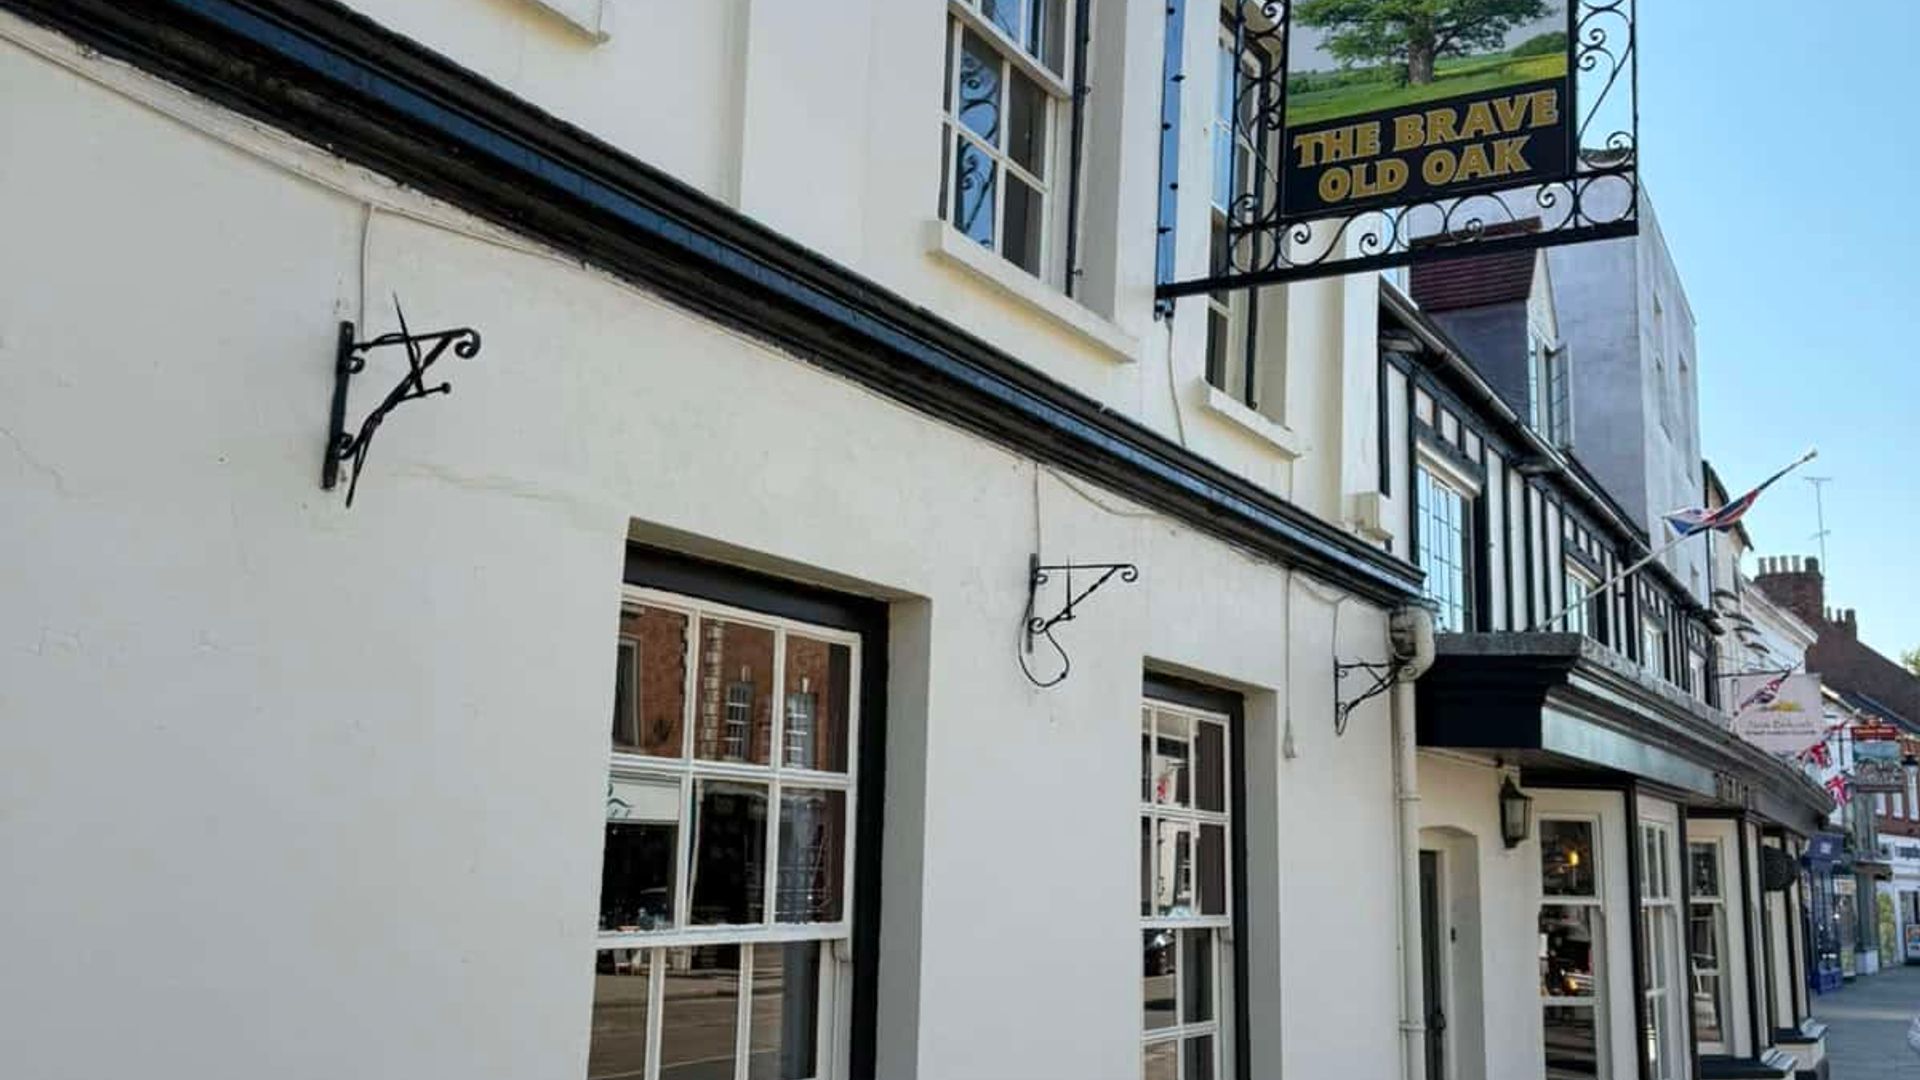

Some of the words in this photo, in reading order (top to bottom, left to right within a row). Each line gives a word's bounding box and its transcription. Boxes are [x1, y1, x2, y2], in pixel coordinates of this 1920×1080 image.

[1293, 121, 1381, 168] THE
[1393, 89, 1558, 151] BRAVE
[1318, 158, 1409, 202] OLD
[1422, 135, 1533, 186] OAK
